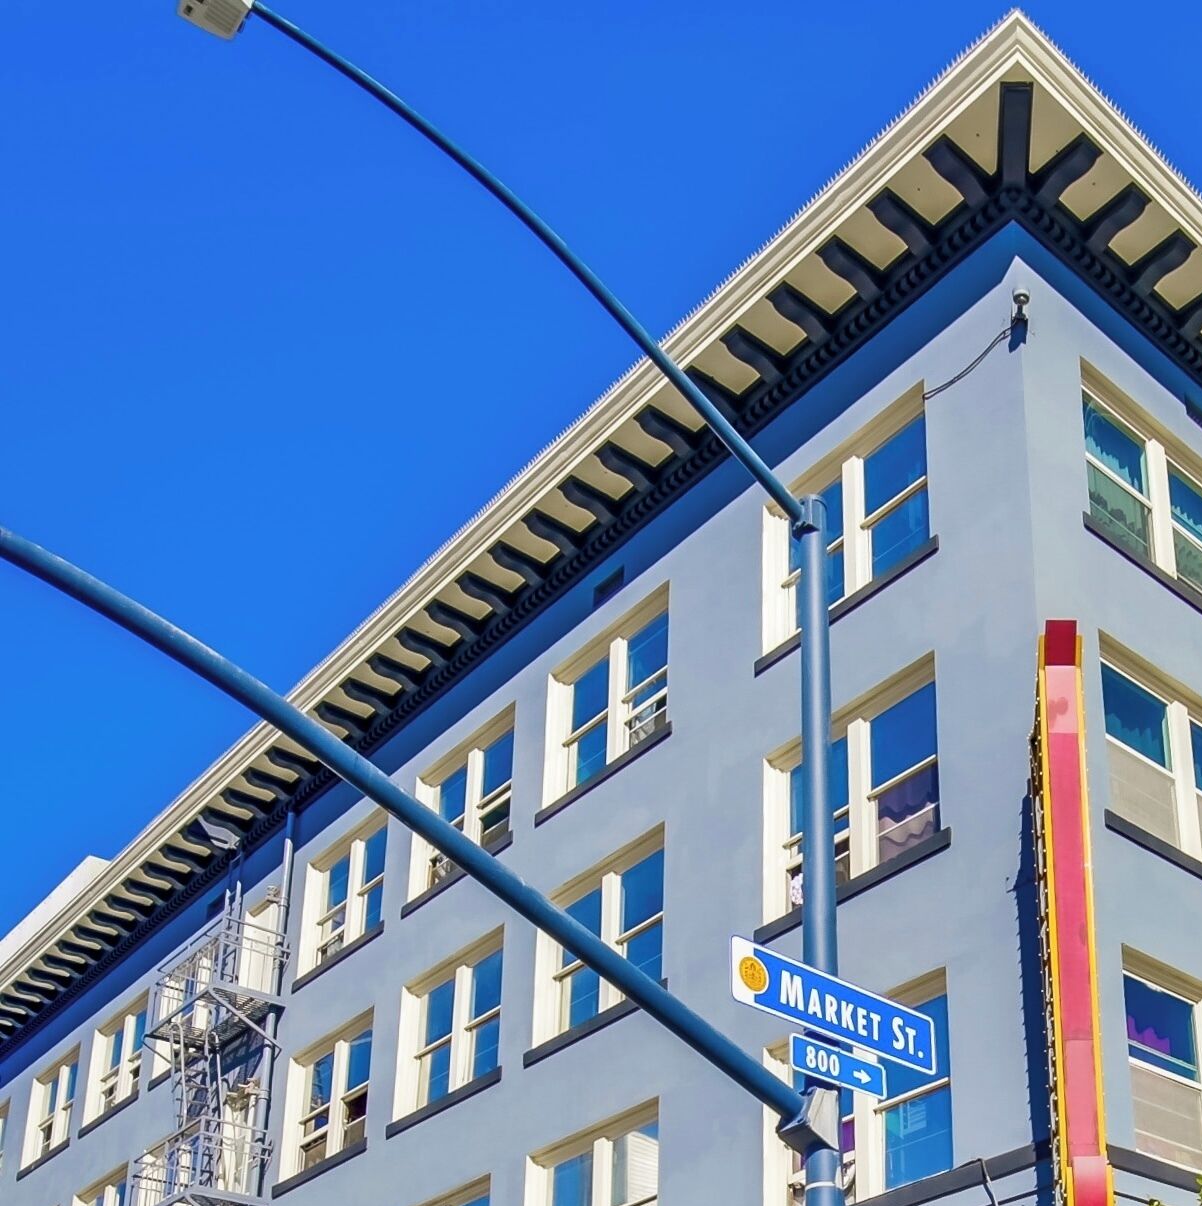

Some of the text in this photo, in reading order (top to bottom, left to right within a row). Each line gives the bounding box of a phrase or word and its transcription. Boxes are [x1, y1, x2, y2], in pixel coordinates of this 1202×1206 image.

[780, 969, 924, 1059] MARKET ST.
[805, 1045, 840, 1077] 800
